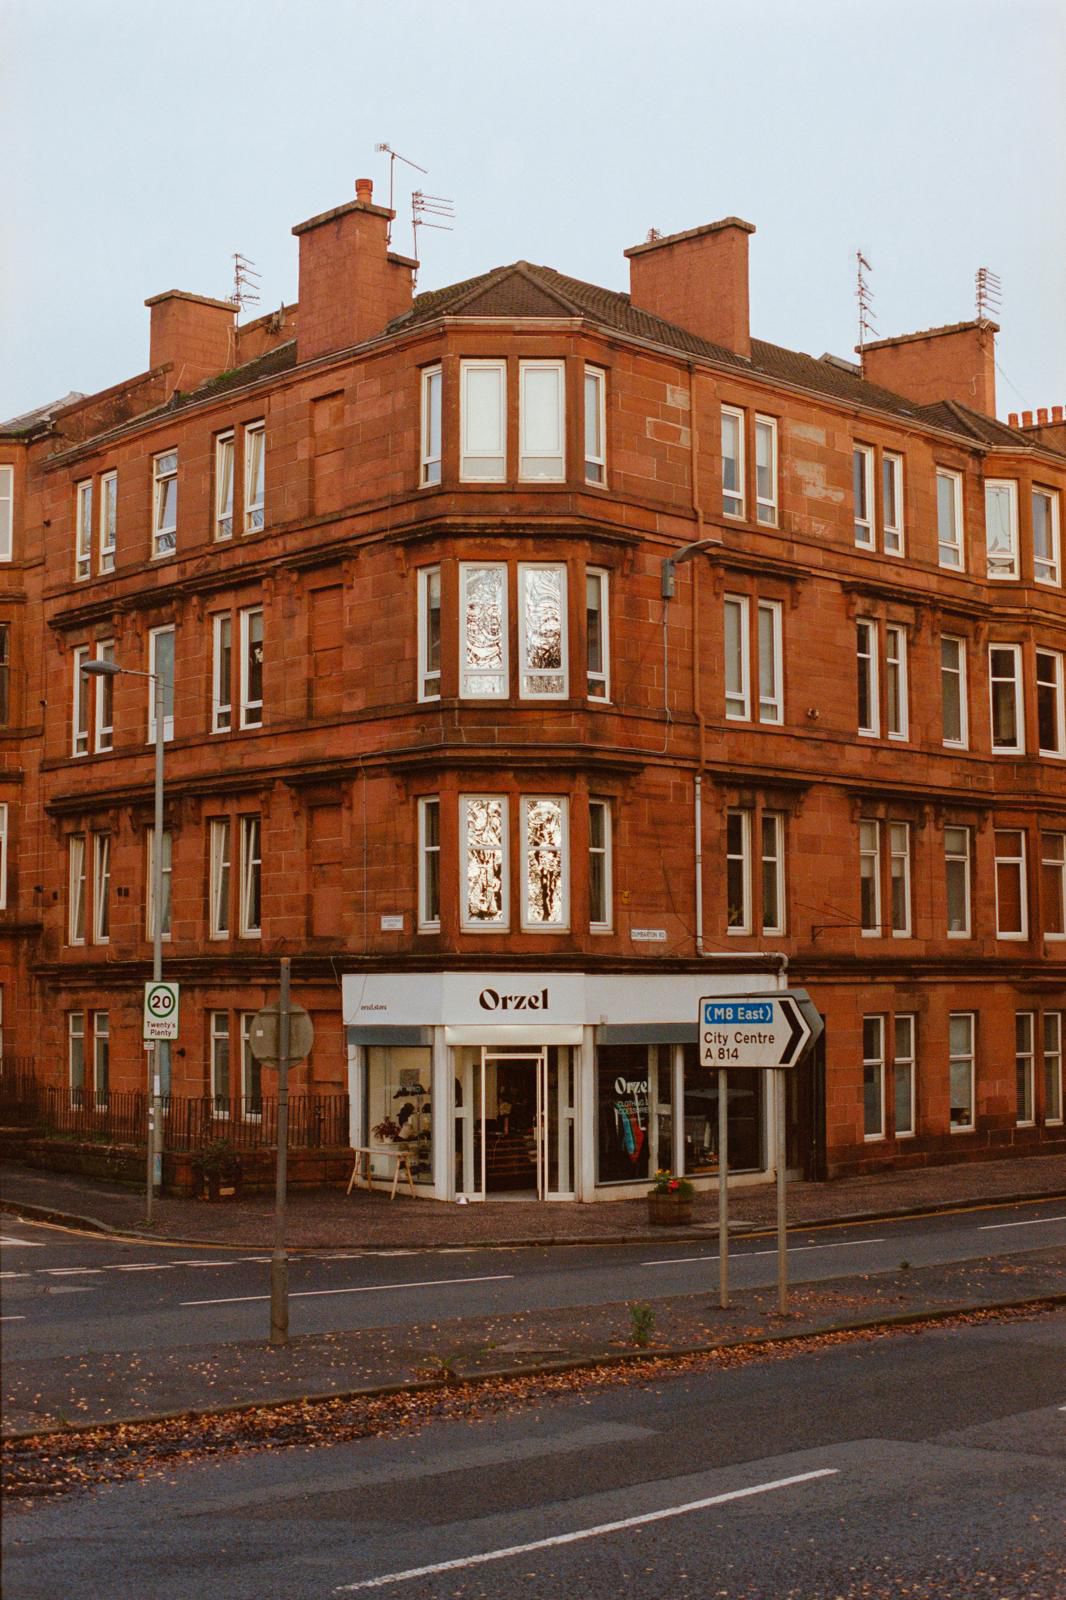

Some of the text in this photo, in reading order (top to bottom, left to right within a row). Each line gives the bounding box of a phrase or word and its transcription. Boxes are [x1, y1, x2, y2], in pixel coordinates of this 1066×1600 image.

[151, 995, 172, 1009] 20
[478, 987, 549, 1011] Orzel
[706, 1005, 772, 1022] (M8 East)
[150, 1029, 172, 1037] Plenty
[704, 1031, 775, 1046] City Centre
[705, 1047, 739, 1060] A 814
